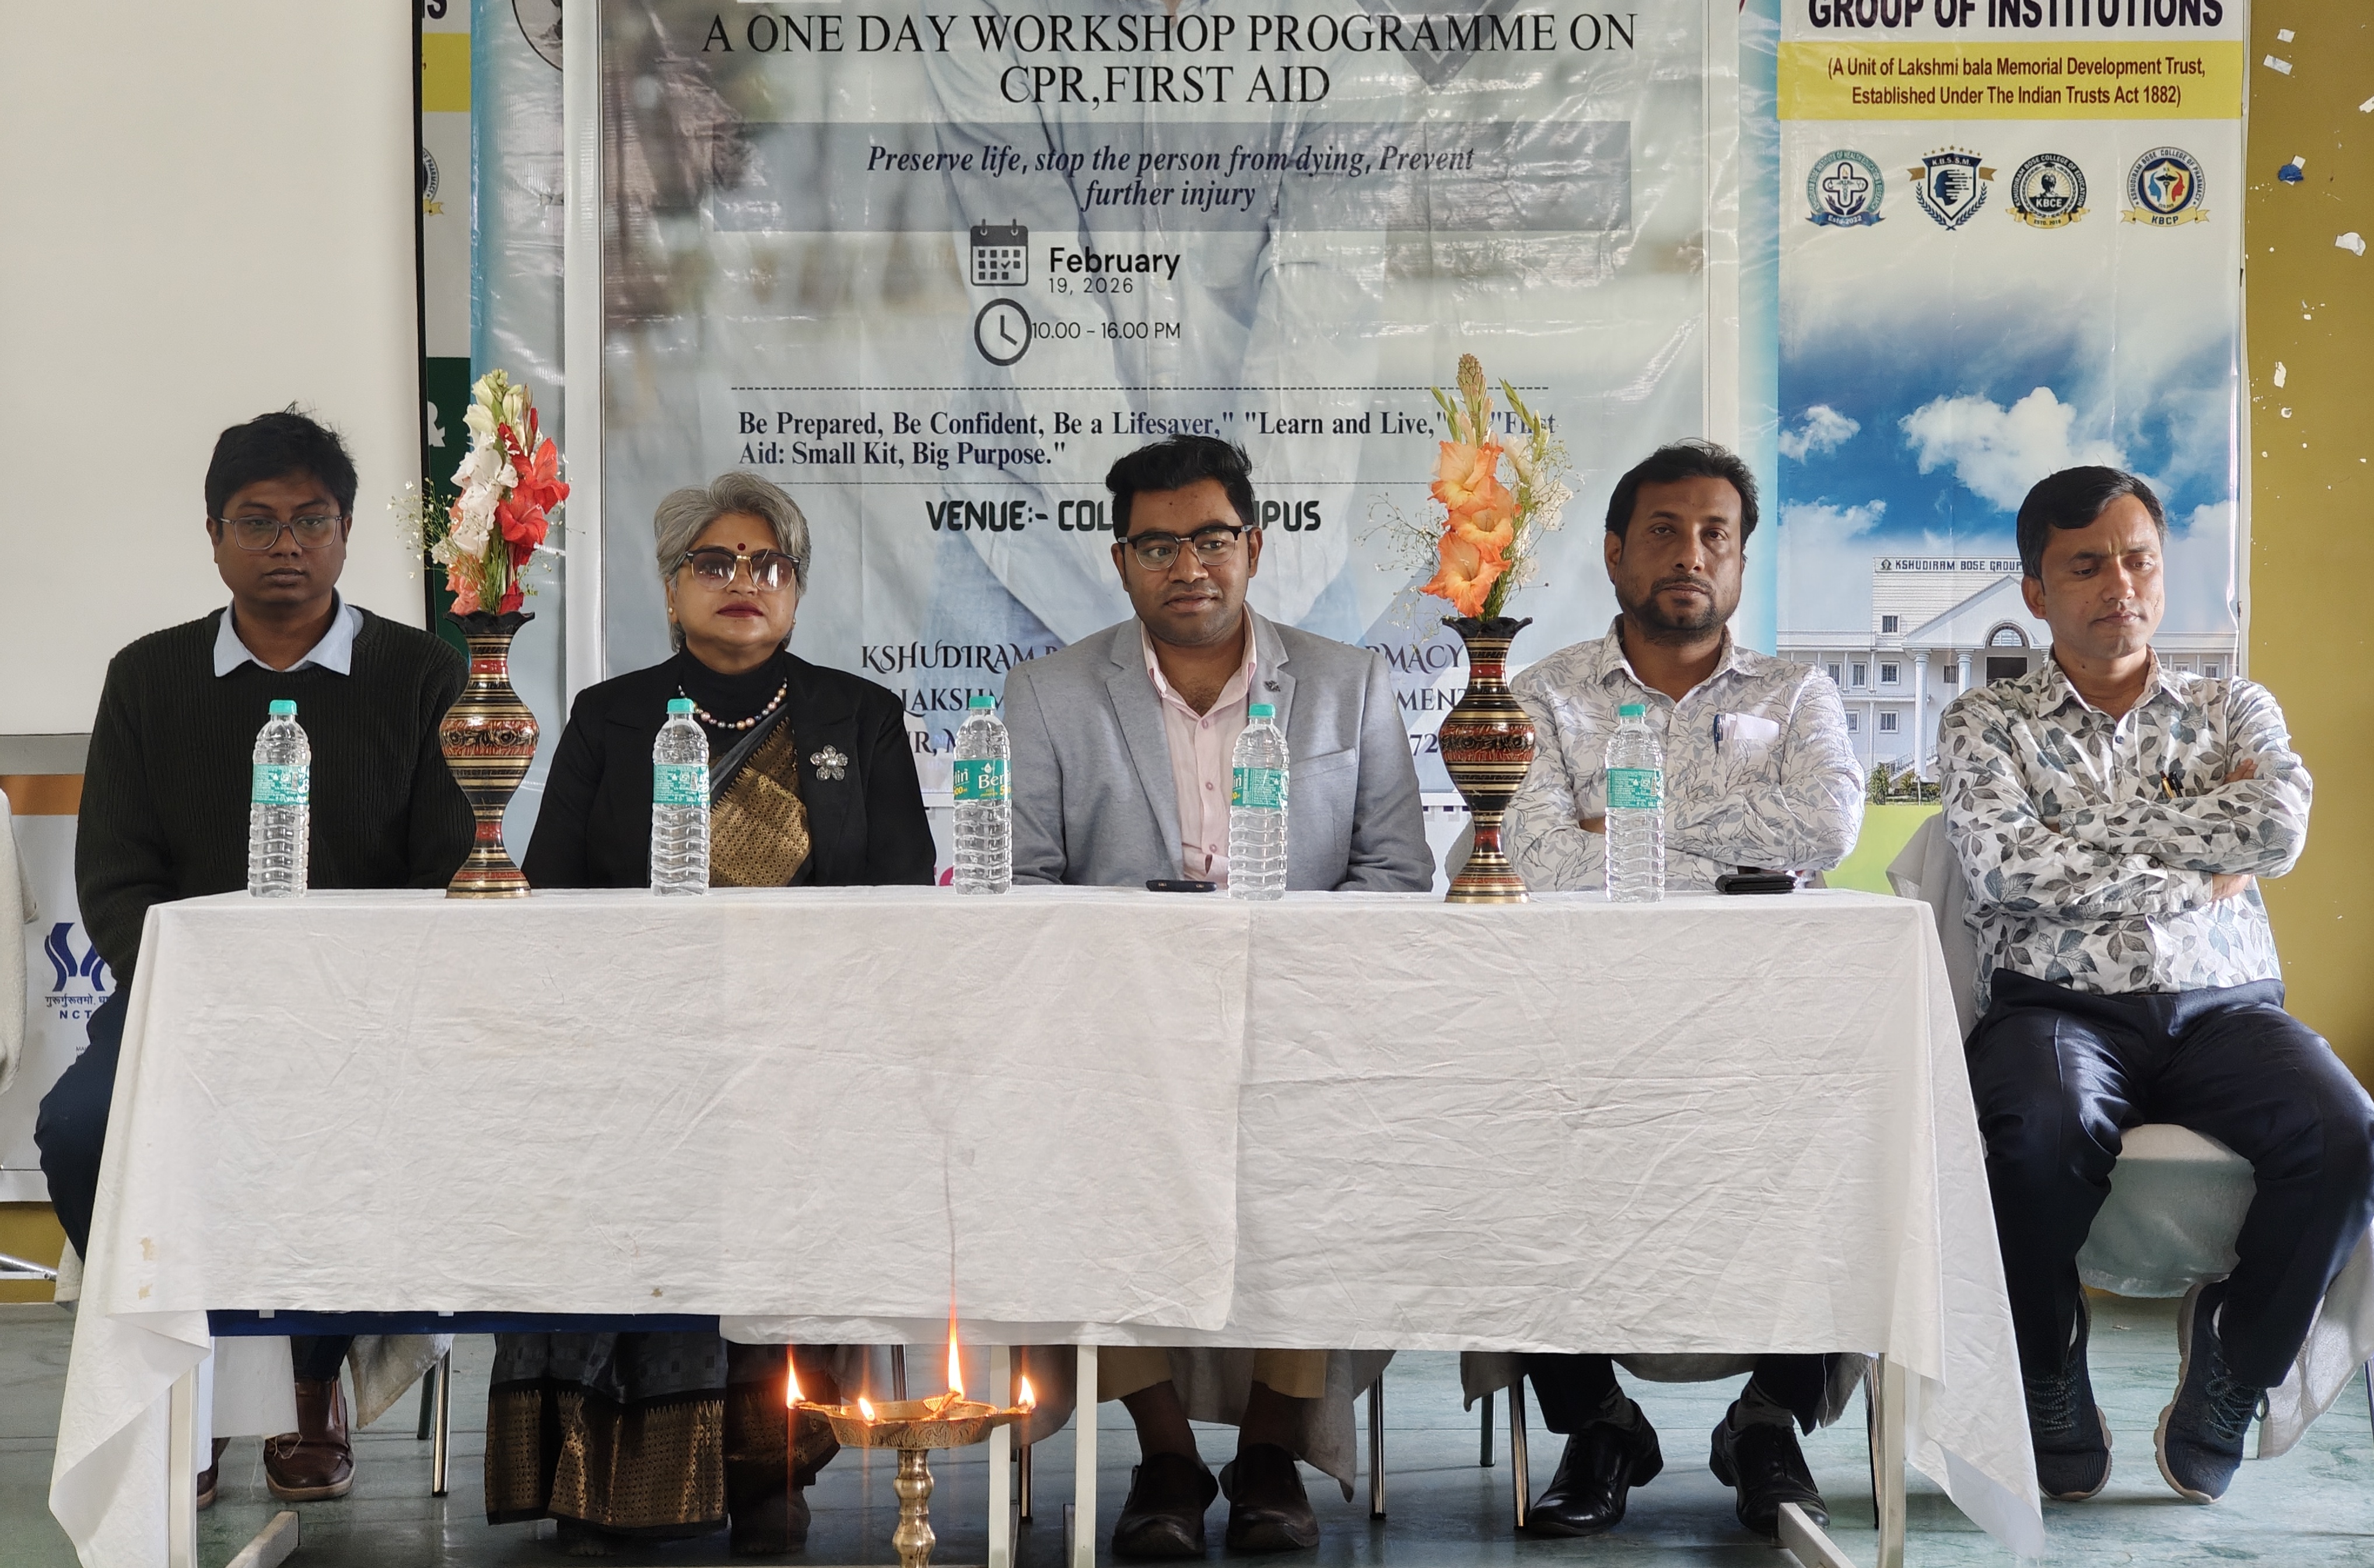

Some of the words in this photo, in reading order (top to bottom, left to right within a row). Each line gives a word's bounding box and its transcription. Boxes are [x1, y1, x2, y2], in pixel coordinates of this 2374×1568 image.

[1809, 0, 1923, 27] GROUP
[1935, 0, 1975, 27] OF
[1988, 0, 2223, 27] INSTITUTIONS
[702, 15, 735, 52] A
[747, 15, 845, 52] ONE
[857, 15, 958, 52] DAY
[973, 15, 1235, 52] WORKSHOP
[1247, 14, 1557, 52] PROGRAMME
[1570, 13, 1637, 51] ON
[1827, 57, 1844, 78] (A
[1847, 57, 1876, 77] Unit
[1880, 57, 1895, 77] of
[1899, 57, 1959, 77] Lakshmi
[1962, 57, 1993, 77] bala
[1997, 57, 2064, 77] Memorial
[2068, 57, 2163, 81] Development
[2165, 57, 2207, 80] Trust,
[1246, 65, 1330, 103] AID
[1853, 86, 1937, 106] Established
[1941, 86, 1984, 106] Under
[1988, 86, 2015, 106] The
[2018, 86, 2063, 106] Indian
[2065, 86, 2112, 106] Trusts
[2114, 86, 2140, 106] Act
[2143, 86, 2182, 107] 1882)
[867, 146, 973, 172] Preserve
[981, 145, 1029, 177] life,
[1035, 147, 1085, 177] stop
[1093, 146, 1131, 172] the
[1136, 151, 1220, 177] person
[1225, 145, 1289, 177] from
[1295, 145, 1372, 177] dying,
[1379, 146, 1475, 172] Prevent
[2130, 163, 2143, 201] KSHUDIRAM
[2141, 152, 2157, 164] BOSE
[2161, 149, 2187, 160] COLLEGE
[2187, 158, 2194, 166] OF
[2192, 167, 2203, 202] PHARMACY
[2012, 169, 2026, 206] KSHUDIRAM
[2024, 156, 2040, 170] BOSE
[2040, 155, 2070, 166] COLLEGE
[2068, 162, 2077, 170] OF
[2074, 169, 2085, 206] EDUCATION
[1080, 180, 1175, 212] further
[1181, 180, 1256, 212] injury
[2036, 198, 2063, 208] KBCE
[2152, 216, 2179, 225] KBCP
[1049, 247, 1181, 281] February
[1049, 278, 1073, 295] 19,
[1082, 277, 1133, 294] 2026
[1032, 322, 1080, 339] 10.00
[1101, 322, 1149, 339] 16.00
[1154, 322, 1181, 338] PM
[739, 412, 768, 434] Be
[776, 411, 884, 440] Prepared,
[892, 412, 922, 434] Be
[930, 411, 1045, 438] Confident,
[1054, 412, 1082, 434] Be
[1090, 418, 1103, 434] a
[1112, 411, 1234, 438] Lifesaver,"
[1244, 411, 1324, 434] "Learn
[1332, 411, 1371, 434] and
[1381, 411, 1447, 438] Live,"
[739, 441, 785, 465] Aid:
[792, 441, 856, 465] Small
[863, 441, 905, 469] Kit,
[912, 441, 950, 470] Big
[957, 441, 1066, 470] Purpose."
[926, 500, 1048, 532] VENUE:-
[1895, 559, 1955, 570] KSHUDIRAM
[1960, 559, 1985, 570] BOSE
[1990, 559, 2023, 572] GROUP
[862, 639, 1034, 674] KSHUDIRAM
